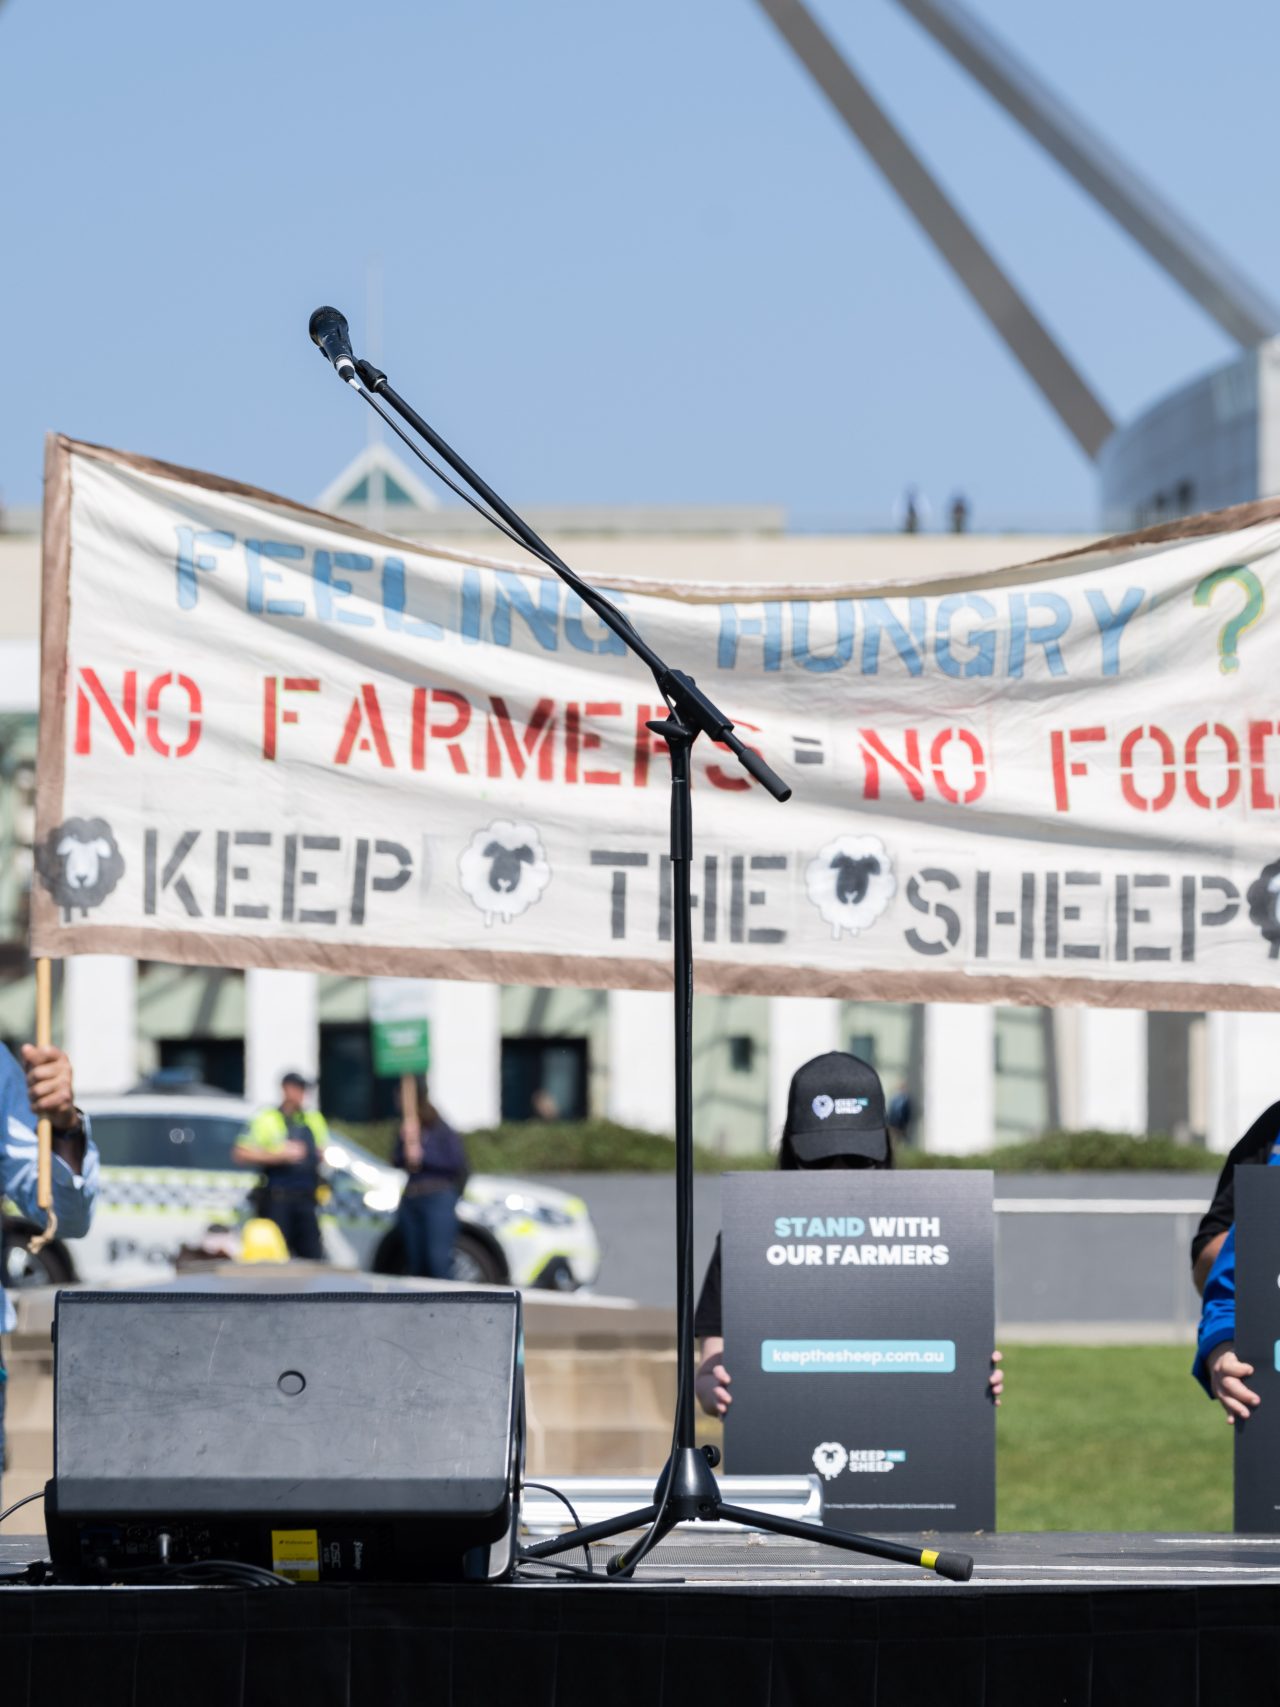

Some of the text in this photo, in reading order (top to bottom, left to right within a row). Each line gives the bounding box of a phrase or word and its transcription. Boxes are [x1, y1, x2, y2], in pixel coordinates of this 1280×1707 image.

[174, 524, 628, 656] FEELING
[716, 587, 1145, 678] HUNGRY
[74, 667, 203, 758] NO
[859, 727, 987, 804] NO
[143, 828, 1240, 962] KEEP THE SHEEP
[774, 1216, 940, 1238] STAND WITH
[766, 1244, 950, 1266] OUR FARMERS
[772, 1348, 945, 1366] keepthesheep.com.au
[849, 1449, 886, 1461] KEEP
[848, 1460, 895, 1473] SHEEP
